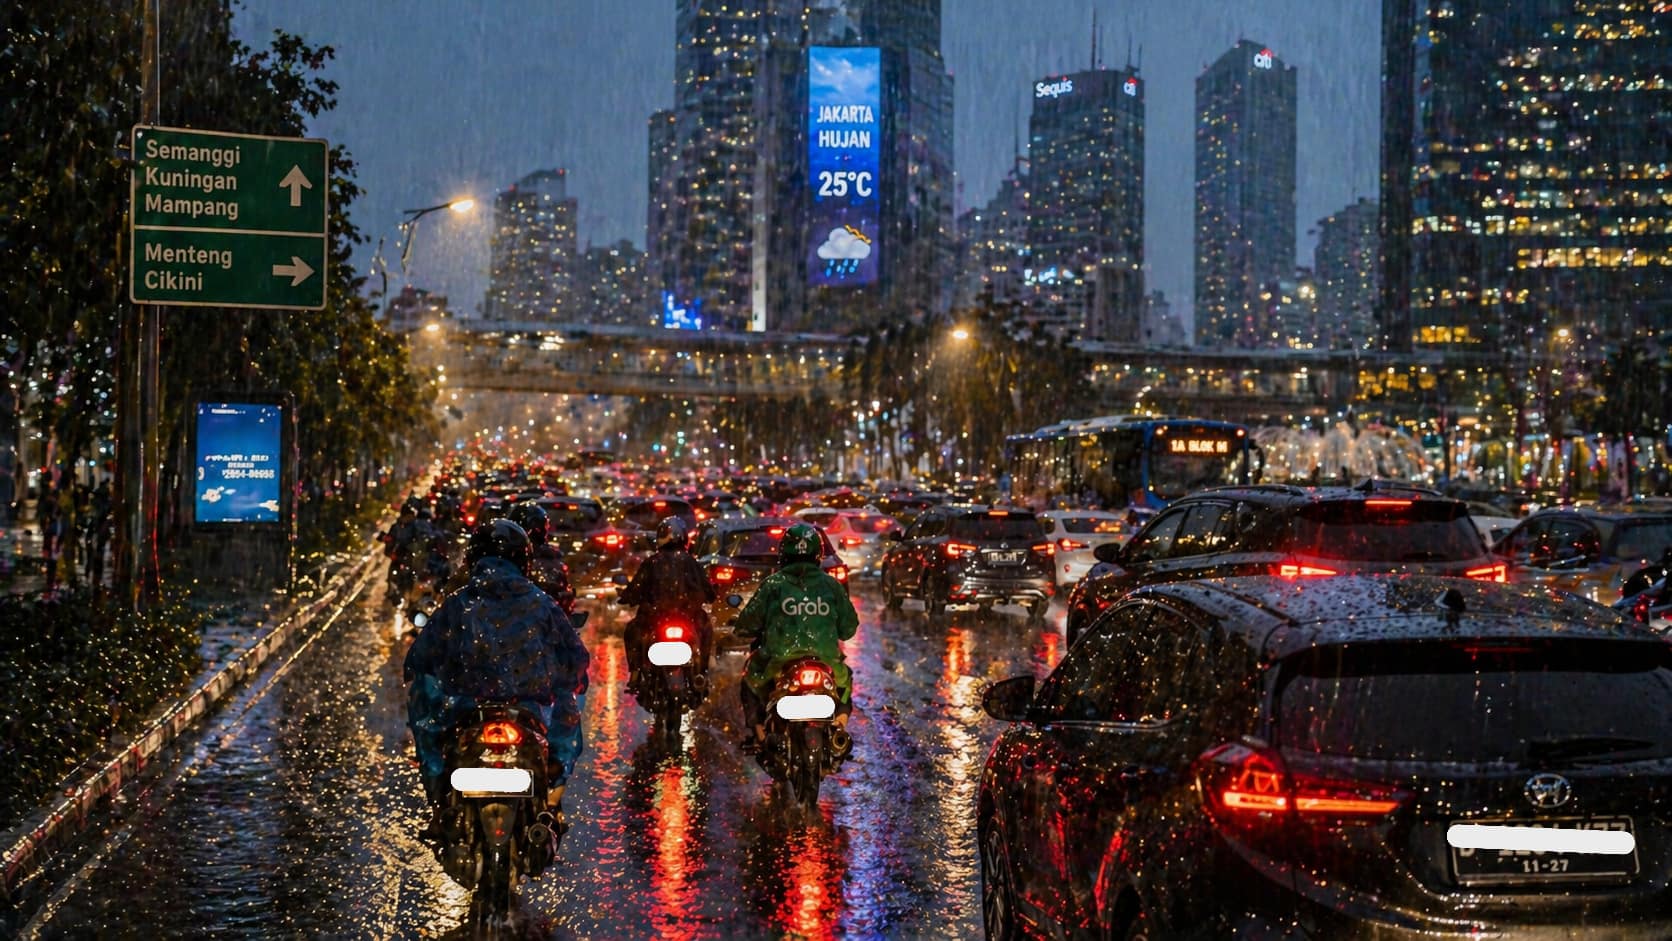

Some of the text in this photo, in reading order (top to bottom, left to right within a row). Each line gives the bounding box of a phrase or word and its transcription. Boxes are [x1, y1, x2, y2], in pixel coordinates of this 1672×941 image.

[1035, 80, 1073, 98] Sequis
[816, 105, 874, 123] JAKARTA
[818, 130, 871, 148] HUJAN
[145, 139, 240, 168] Semanggi
[145, 166, 237, 193] Kuningan
[818, 170, 872, 197] 25°C
[145, 193, 239, 220] Mampang
[145, 242, 233, 269] Menteng
[144, 270, 203, 291] Cikini
[782, 596, 830, 616] Grab
[1522, 859, 1569, 873] 11-27
